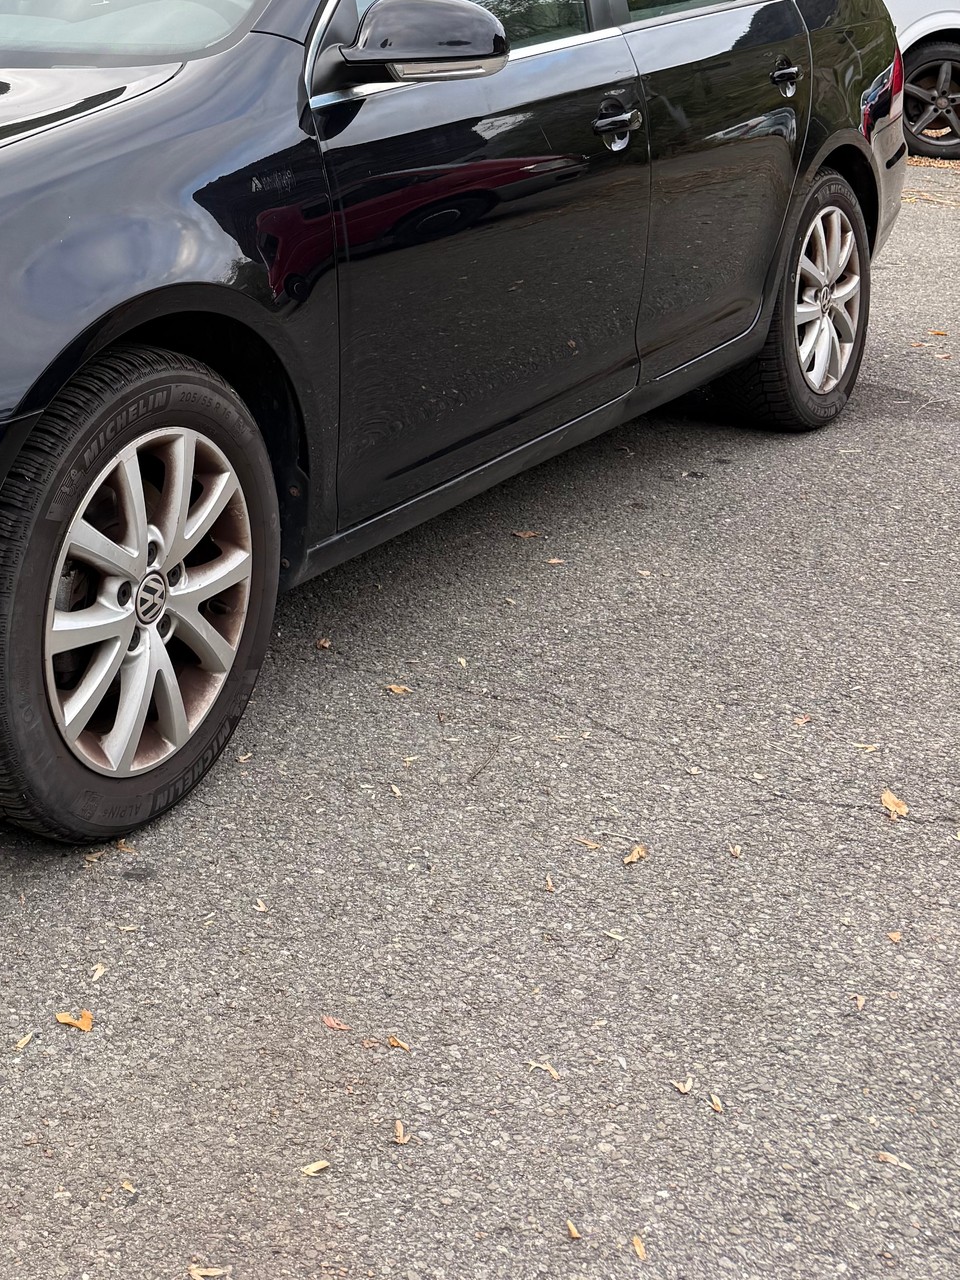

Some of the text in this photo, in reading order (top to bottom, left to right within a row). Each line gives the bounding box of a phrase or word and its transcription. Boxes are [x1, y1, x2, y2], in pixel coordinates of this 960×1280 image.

[83, 390, 168, 467] MICHELIN
[179, 391, 232, 420] 205/55 R 16
[155, 720, 231, 810] MICHELIN
